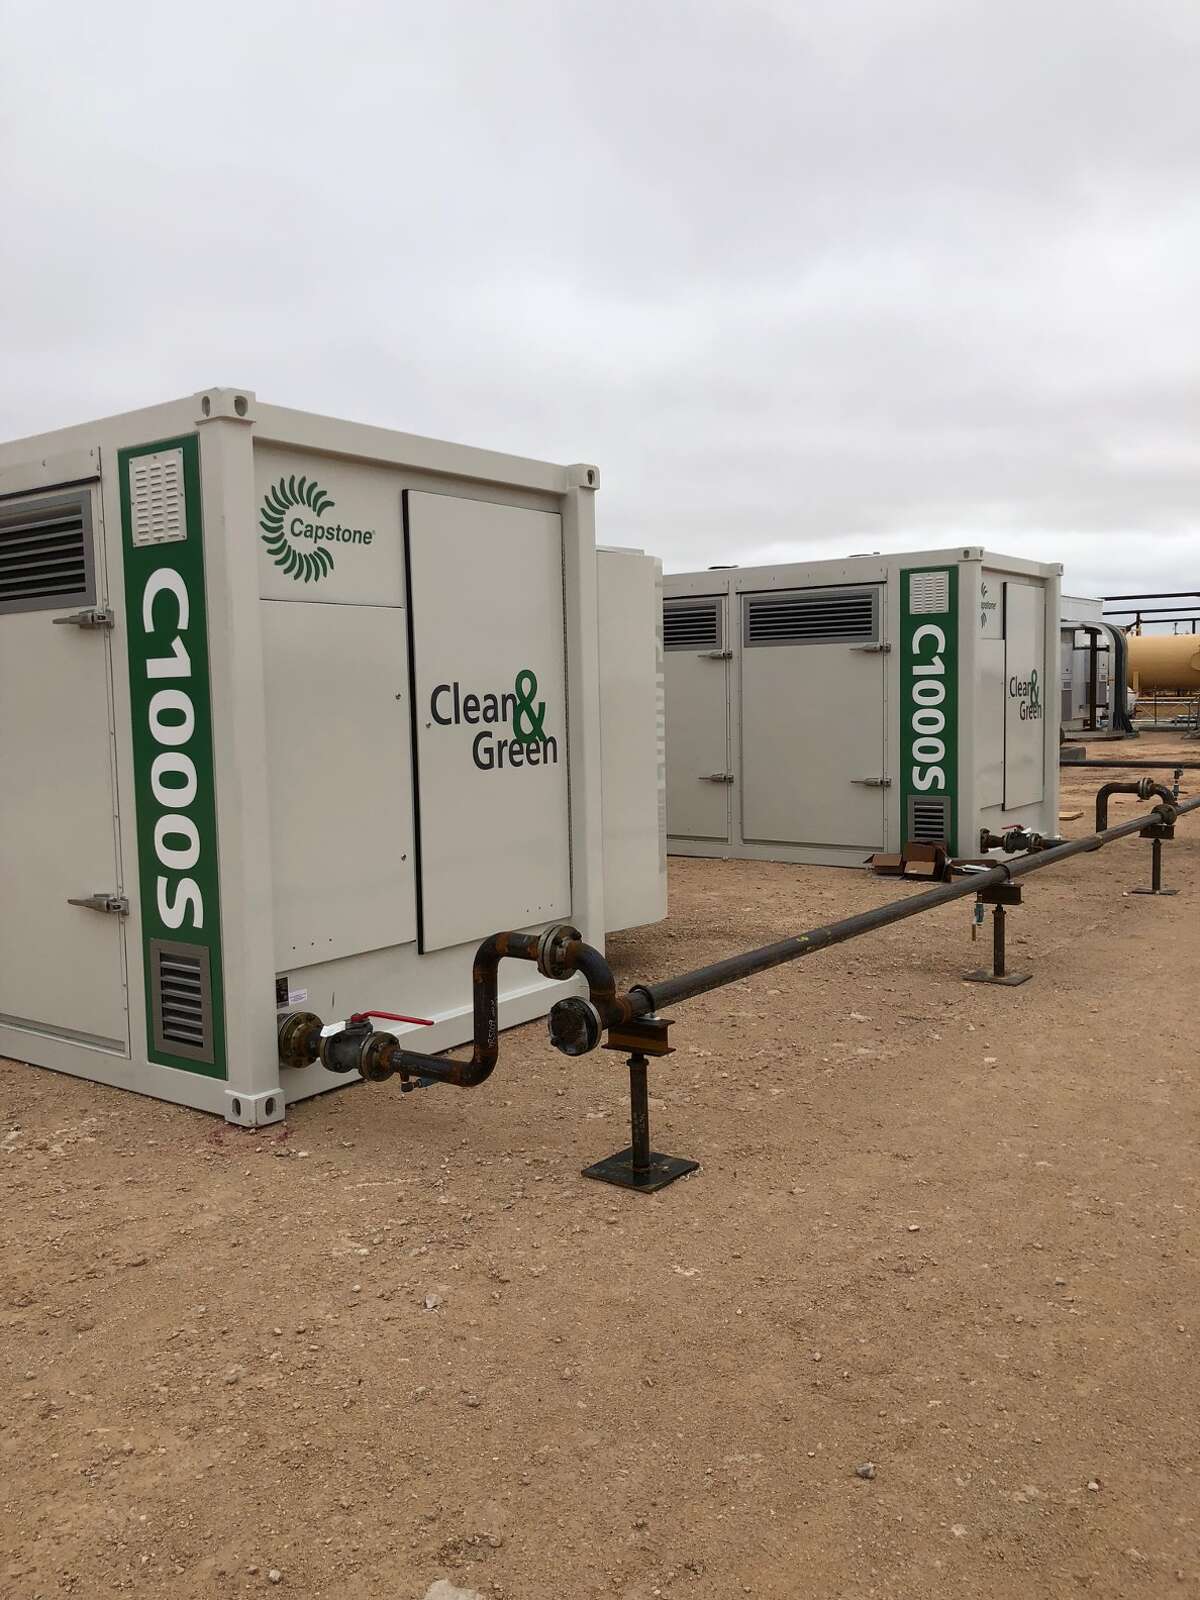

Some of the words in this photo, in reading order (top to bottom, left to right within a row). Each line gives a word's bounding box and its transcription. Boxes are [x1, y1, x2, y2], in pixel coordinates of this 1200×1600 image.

[290, 518, 373, 545] Capstone
[911, 624, 946, 791] C1000S
[1019, 700, 1042, 721] Green
[142, 567, 204, 929] C1000S
[472, 730, 558, 770] Green
